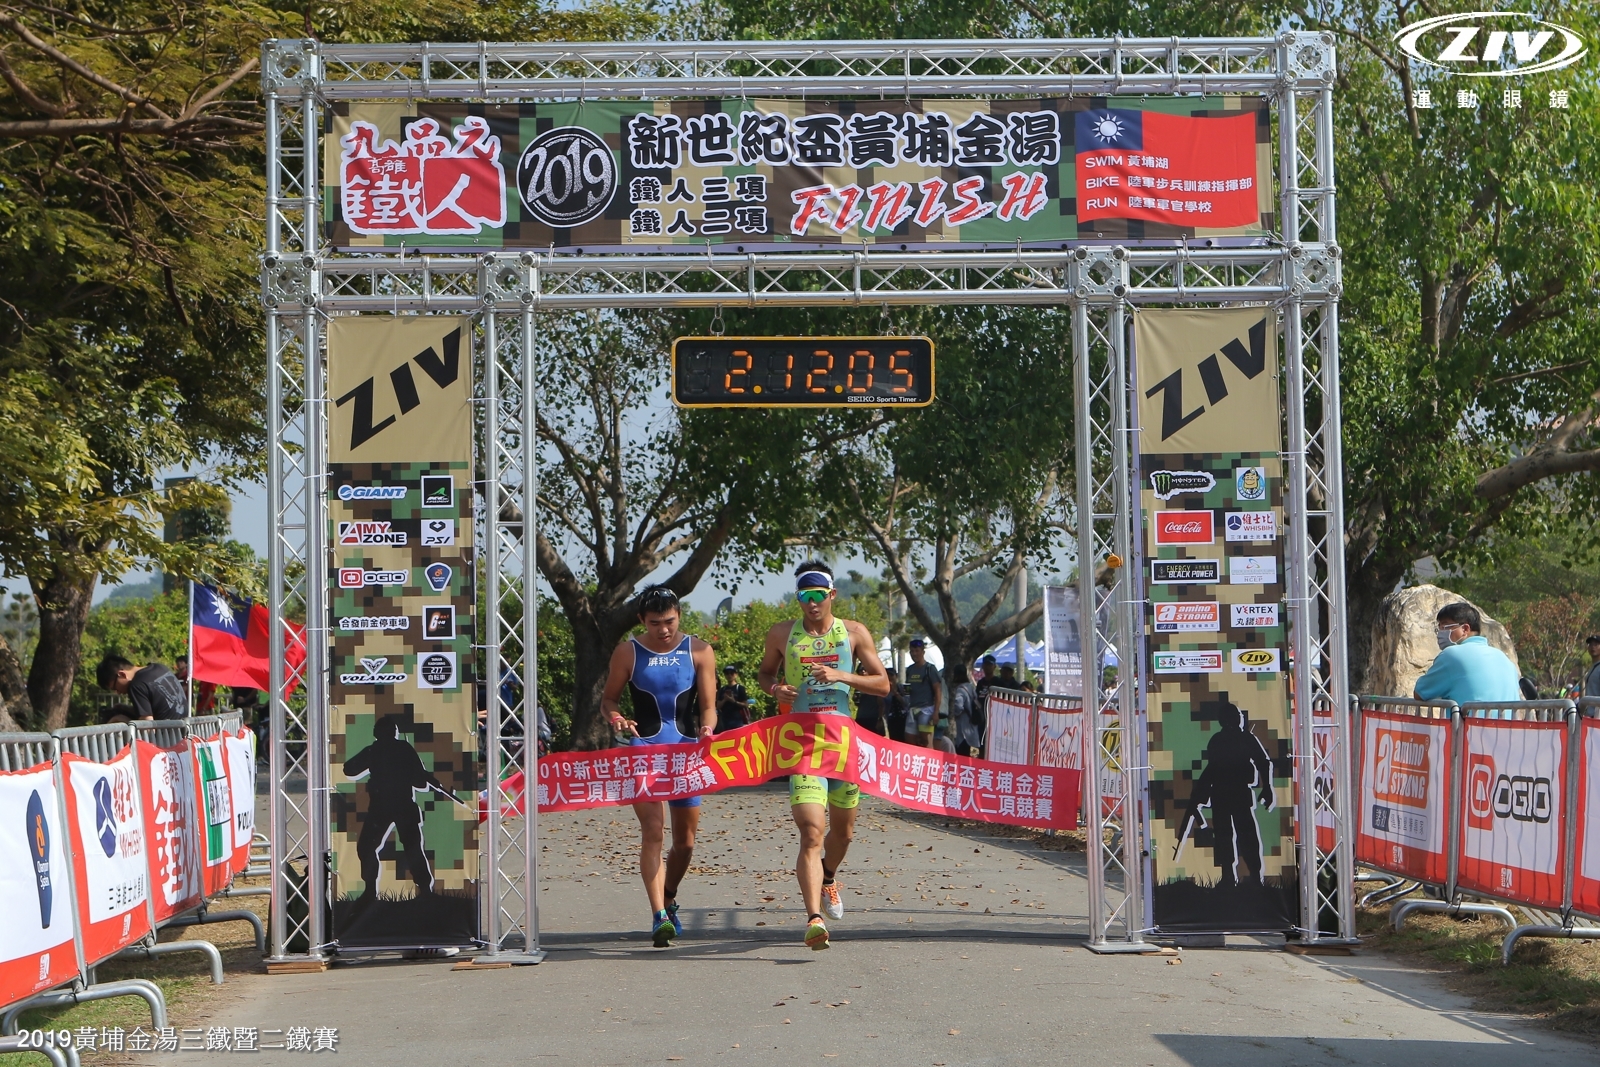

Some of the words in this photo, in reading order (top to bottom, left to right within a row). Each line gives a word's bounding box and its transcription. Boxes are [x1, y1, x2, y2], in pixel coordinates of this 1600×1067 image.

[629, 112, 1060, 166] 新世紀盃黃埔金湯
[368, 158, 408, 175] 高雄
[1085, 155, 1123, 168] SWIM
[1127, 155, 1169, 170] 黃埔湖
[526, 137, 614, 207] 2019
[629, 175, 767, 203] 鐵人三項
[1086, 176, 1120, 189] BIKE
[1127, 177, 1252, 193] 陸軍步兵訓練指揮部
[791, 172, 1049, 236] FINISH
[1086, 197, 1118, 210] RUN
[1128, 196, 1212, 213] 陸軍軍官學校
[629, 208, 767, 235] 鐵人二項
[1145, 317, 1267, 442] ZIV
[335, 326, 461, 452] ZIV
[847, 395, 875, 403] SEIKO
[876, 396, 897, 404] Sports
[353, 488, 405, 497] GIANT
[1242, 513, 1273, 525] 維士比
[362, 533, 405, 543] ZONE
[1166, 565, 1191, 573] ENERGY
[1168, 570, 1191, 578] BLACK
[1191, 569, 1214, 578] POWER
[364, 573, 405, 583] OGIO
[1236, 606, 1273, 614] VERTEX
[1246, 654, 1267, 662] ZIV
[430, 666, 443, 674] 277
[710, 721, 850, 780] FINISH
[1393, 737, 1425, 767] amino
[879, 747, 1053, 798] 2019新世紀盃黃埔金湯
[879, 769, 1053, 821] 鐵人三項暨鐵人二項競賽
[1390, 773, 1426, 800] STRONG
[1493, 773, 1551, 823] OGIO
